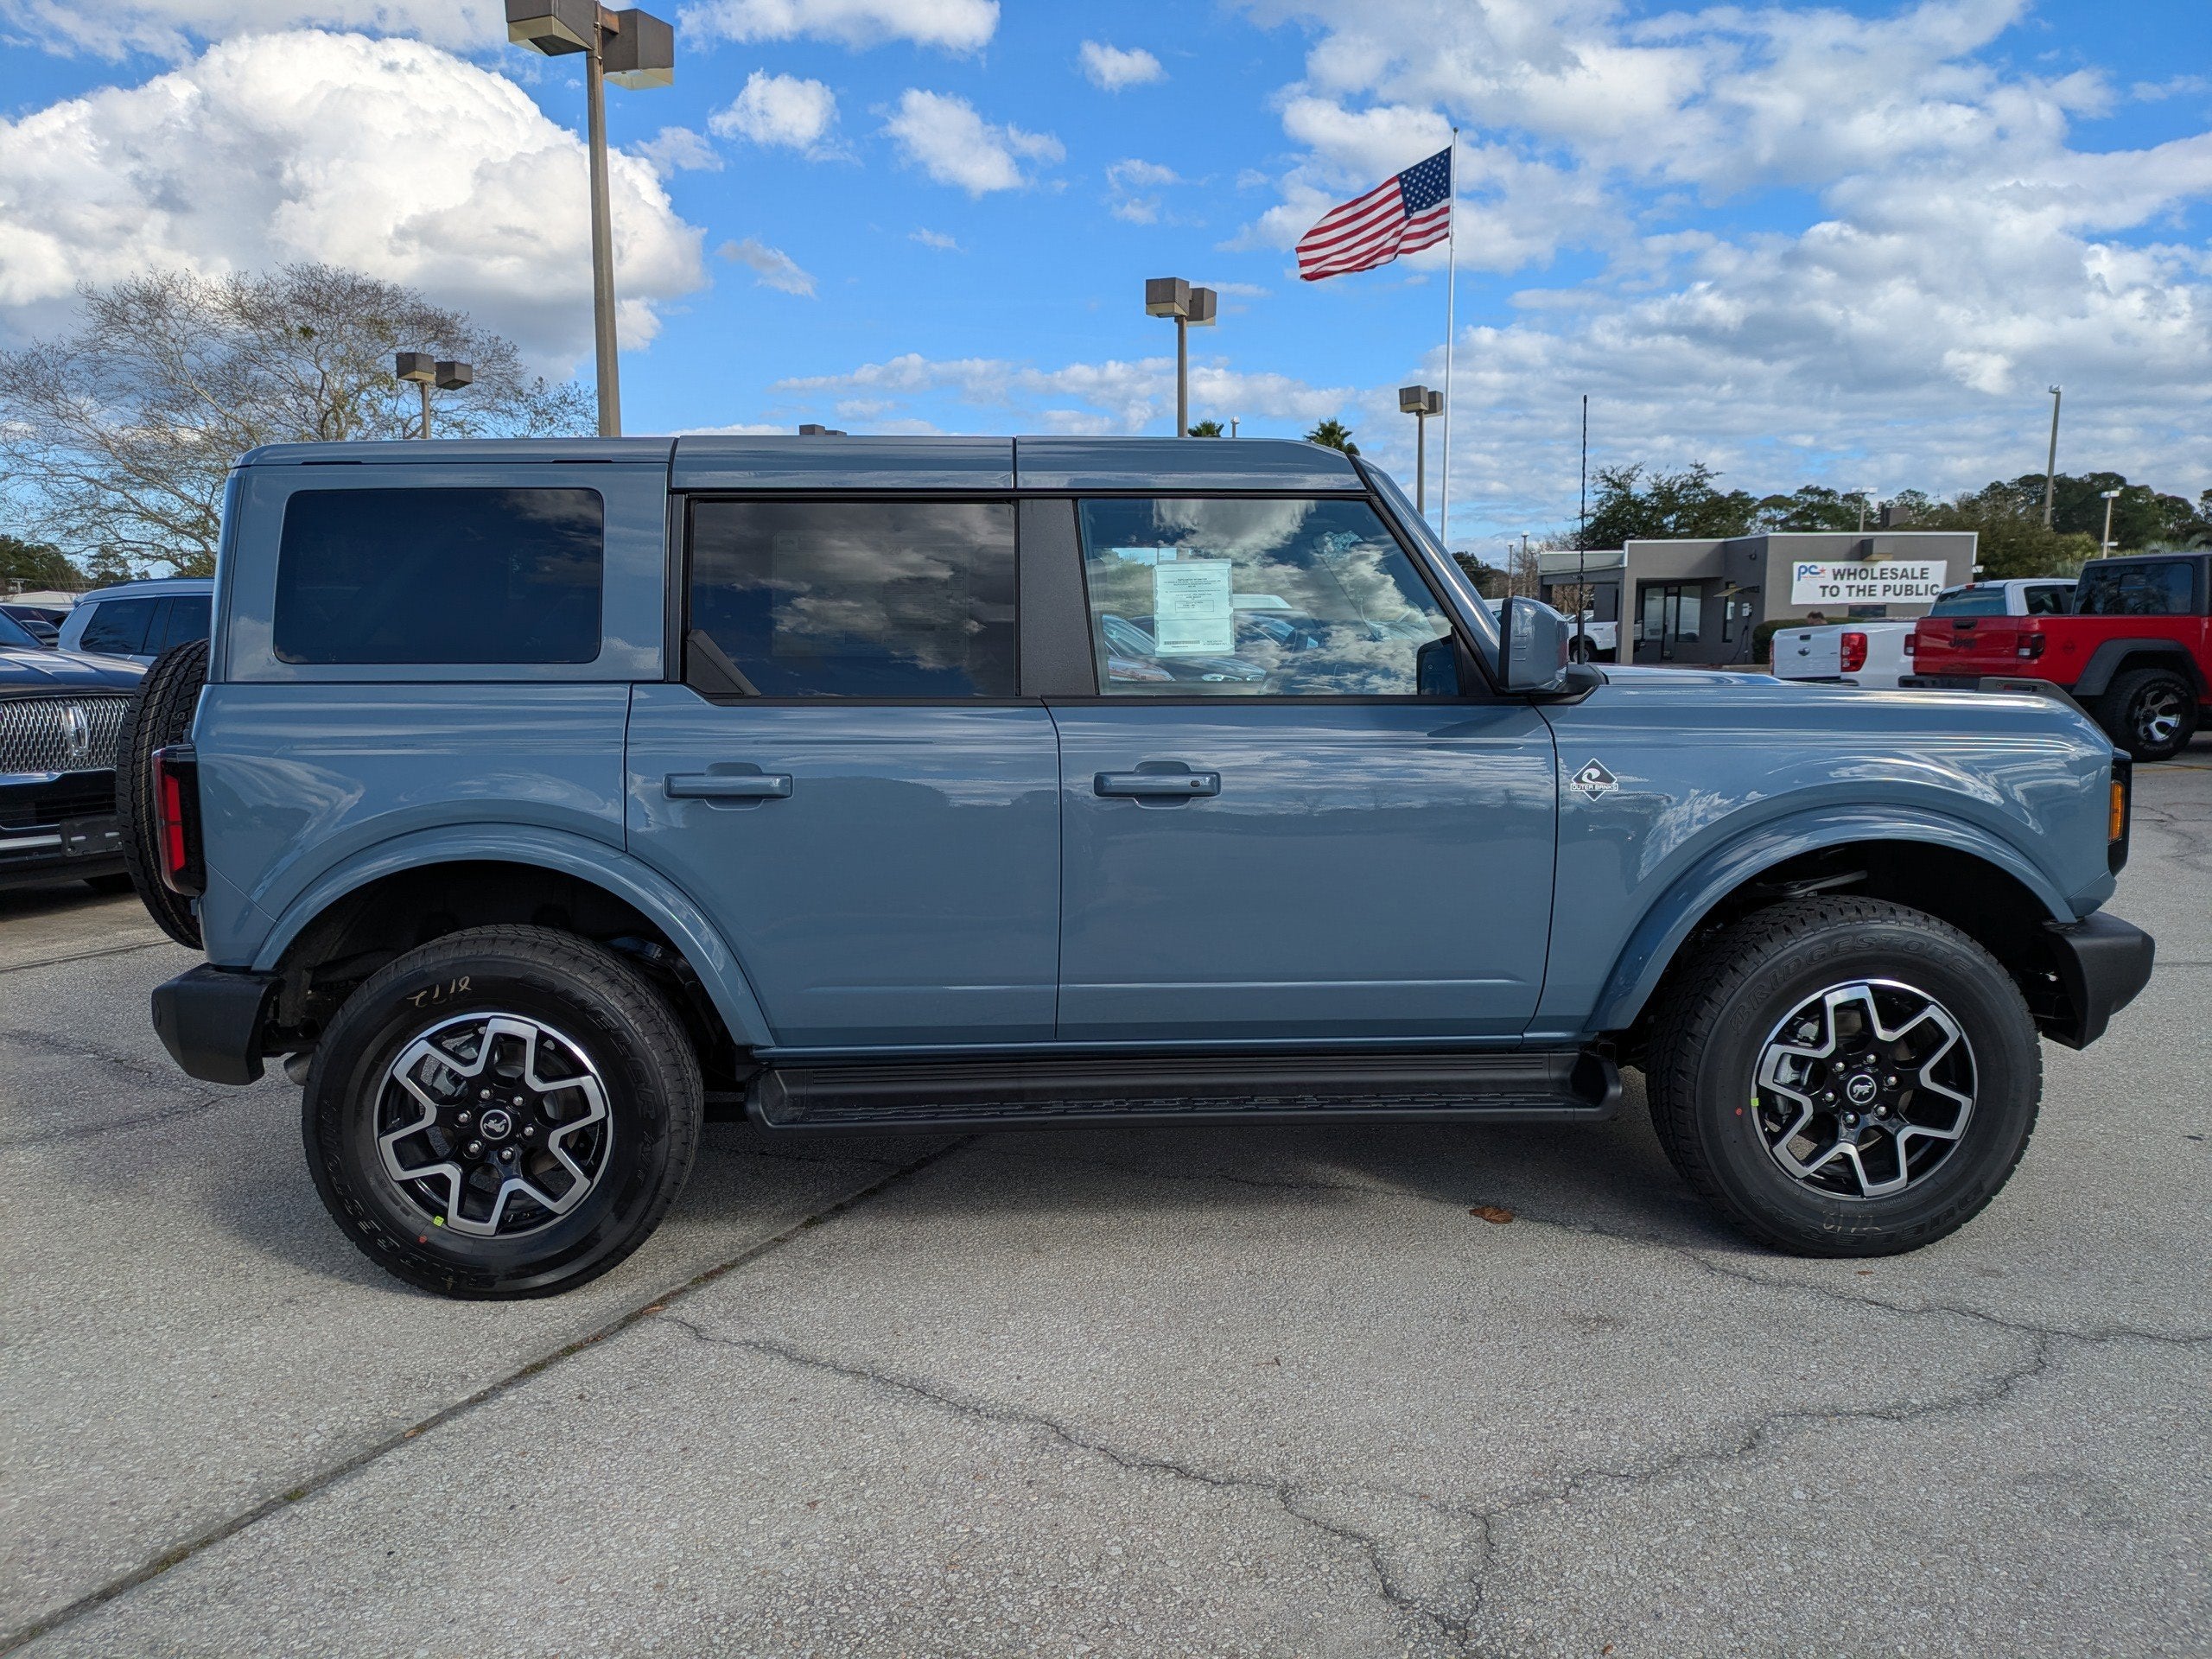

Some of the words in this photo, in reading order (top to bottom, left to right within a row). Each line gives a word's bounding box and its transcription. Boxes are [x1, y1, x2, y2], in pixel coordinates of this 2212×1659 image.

[1832, 567, 1929, 582] WHOLESALE
[1819, 585, 1840, 598] TO
[1846, 584, 1878, 597] THE
[1882, 583, 1940, 597] PUBLIC
[1729, 931, 1974, 1033] BRIDGESTONE
